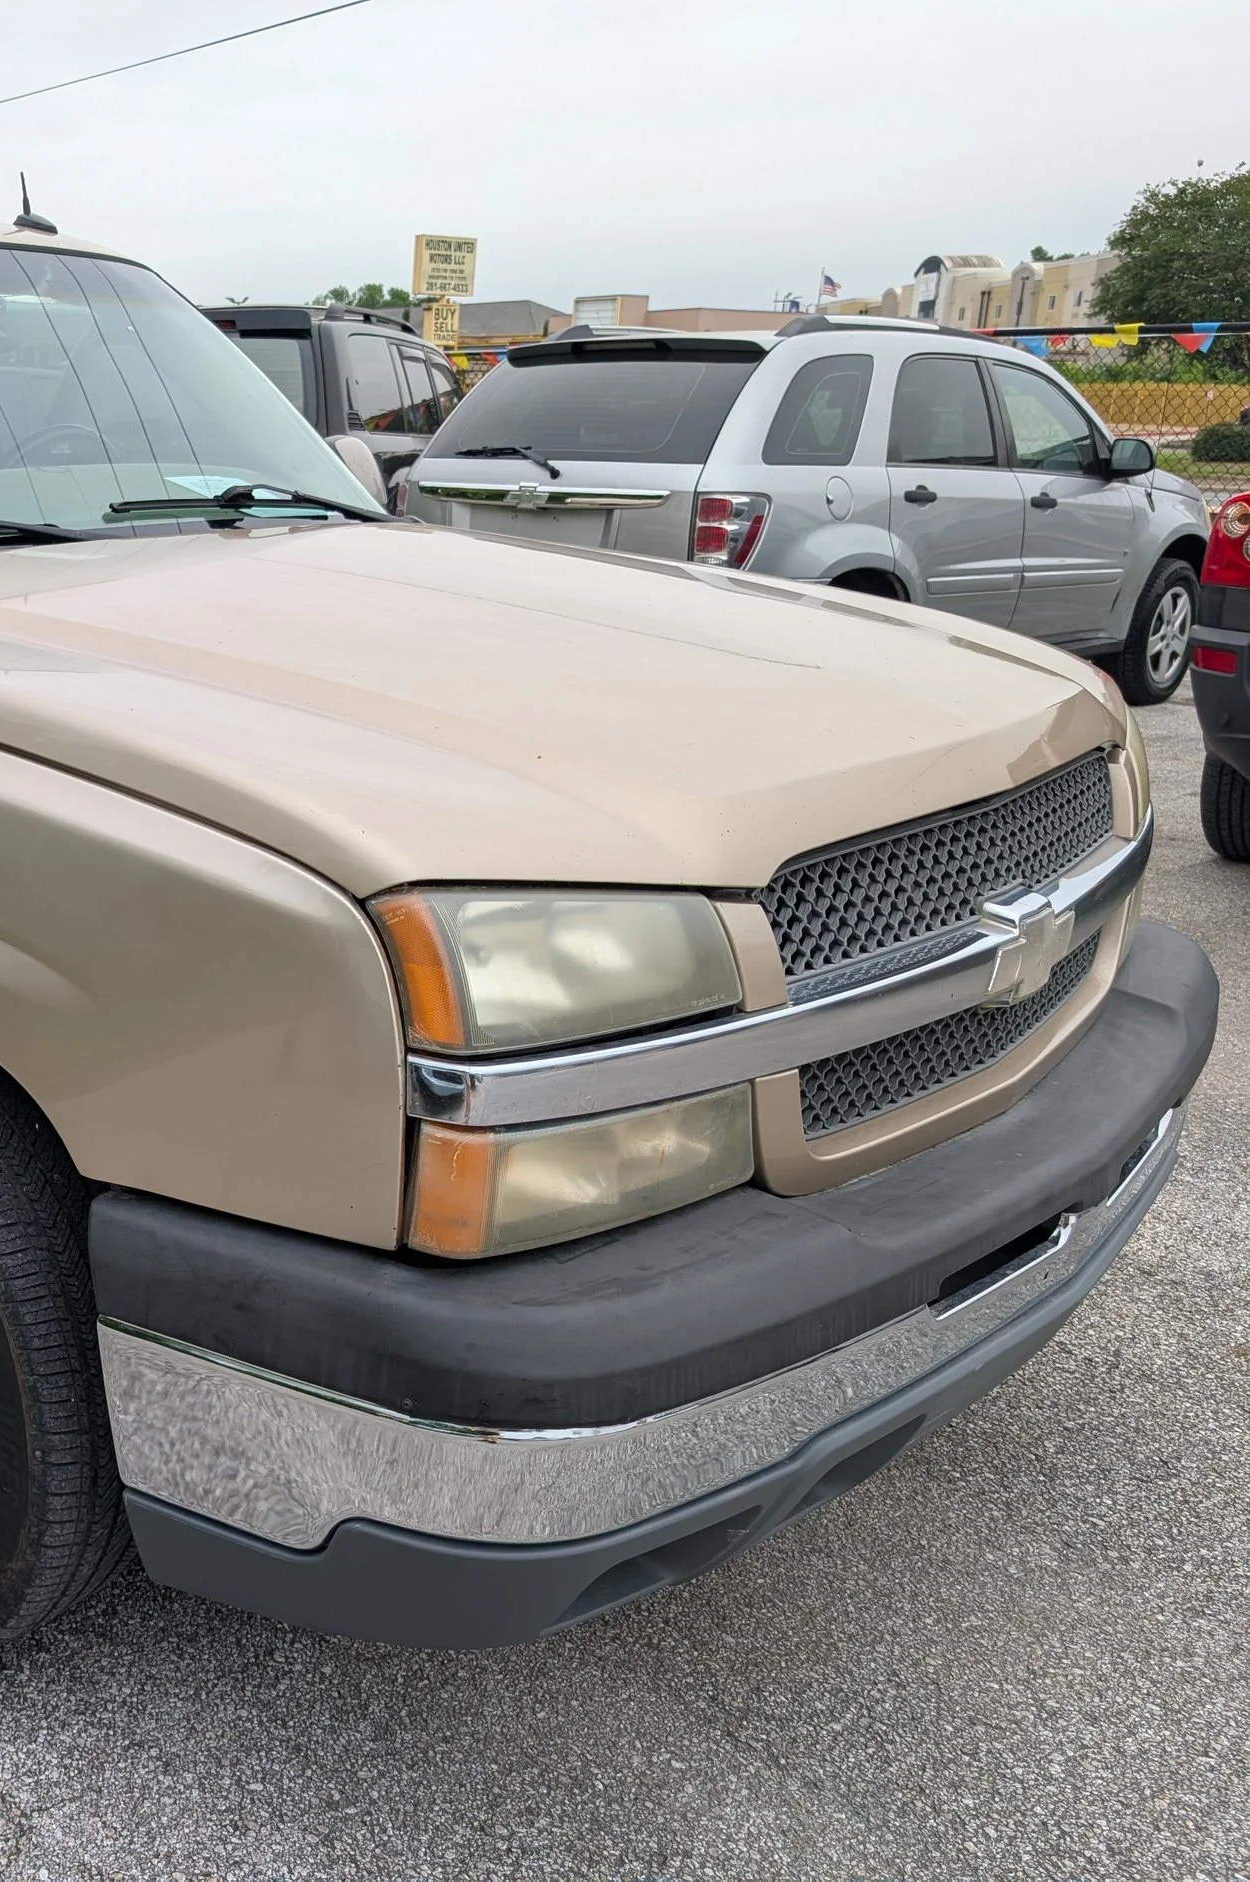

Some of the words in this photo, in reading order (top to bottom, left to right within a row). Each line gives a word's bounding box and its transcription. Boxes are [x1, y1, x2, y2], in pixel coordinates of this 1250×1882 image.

[425, 239, 452, 252] HOUSTON
[453, 241, 474, 254] UNITED
[429, 253, 451, 264] MOTORS
[453, 254, 466, 265] LLC
[434, 308, 457, 321] BUY
[433, 321, 457, 333] SELL
[433, 333, 457, 342] TRADE
